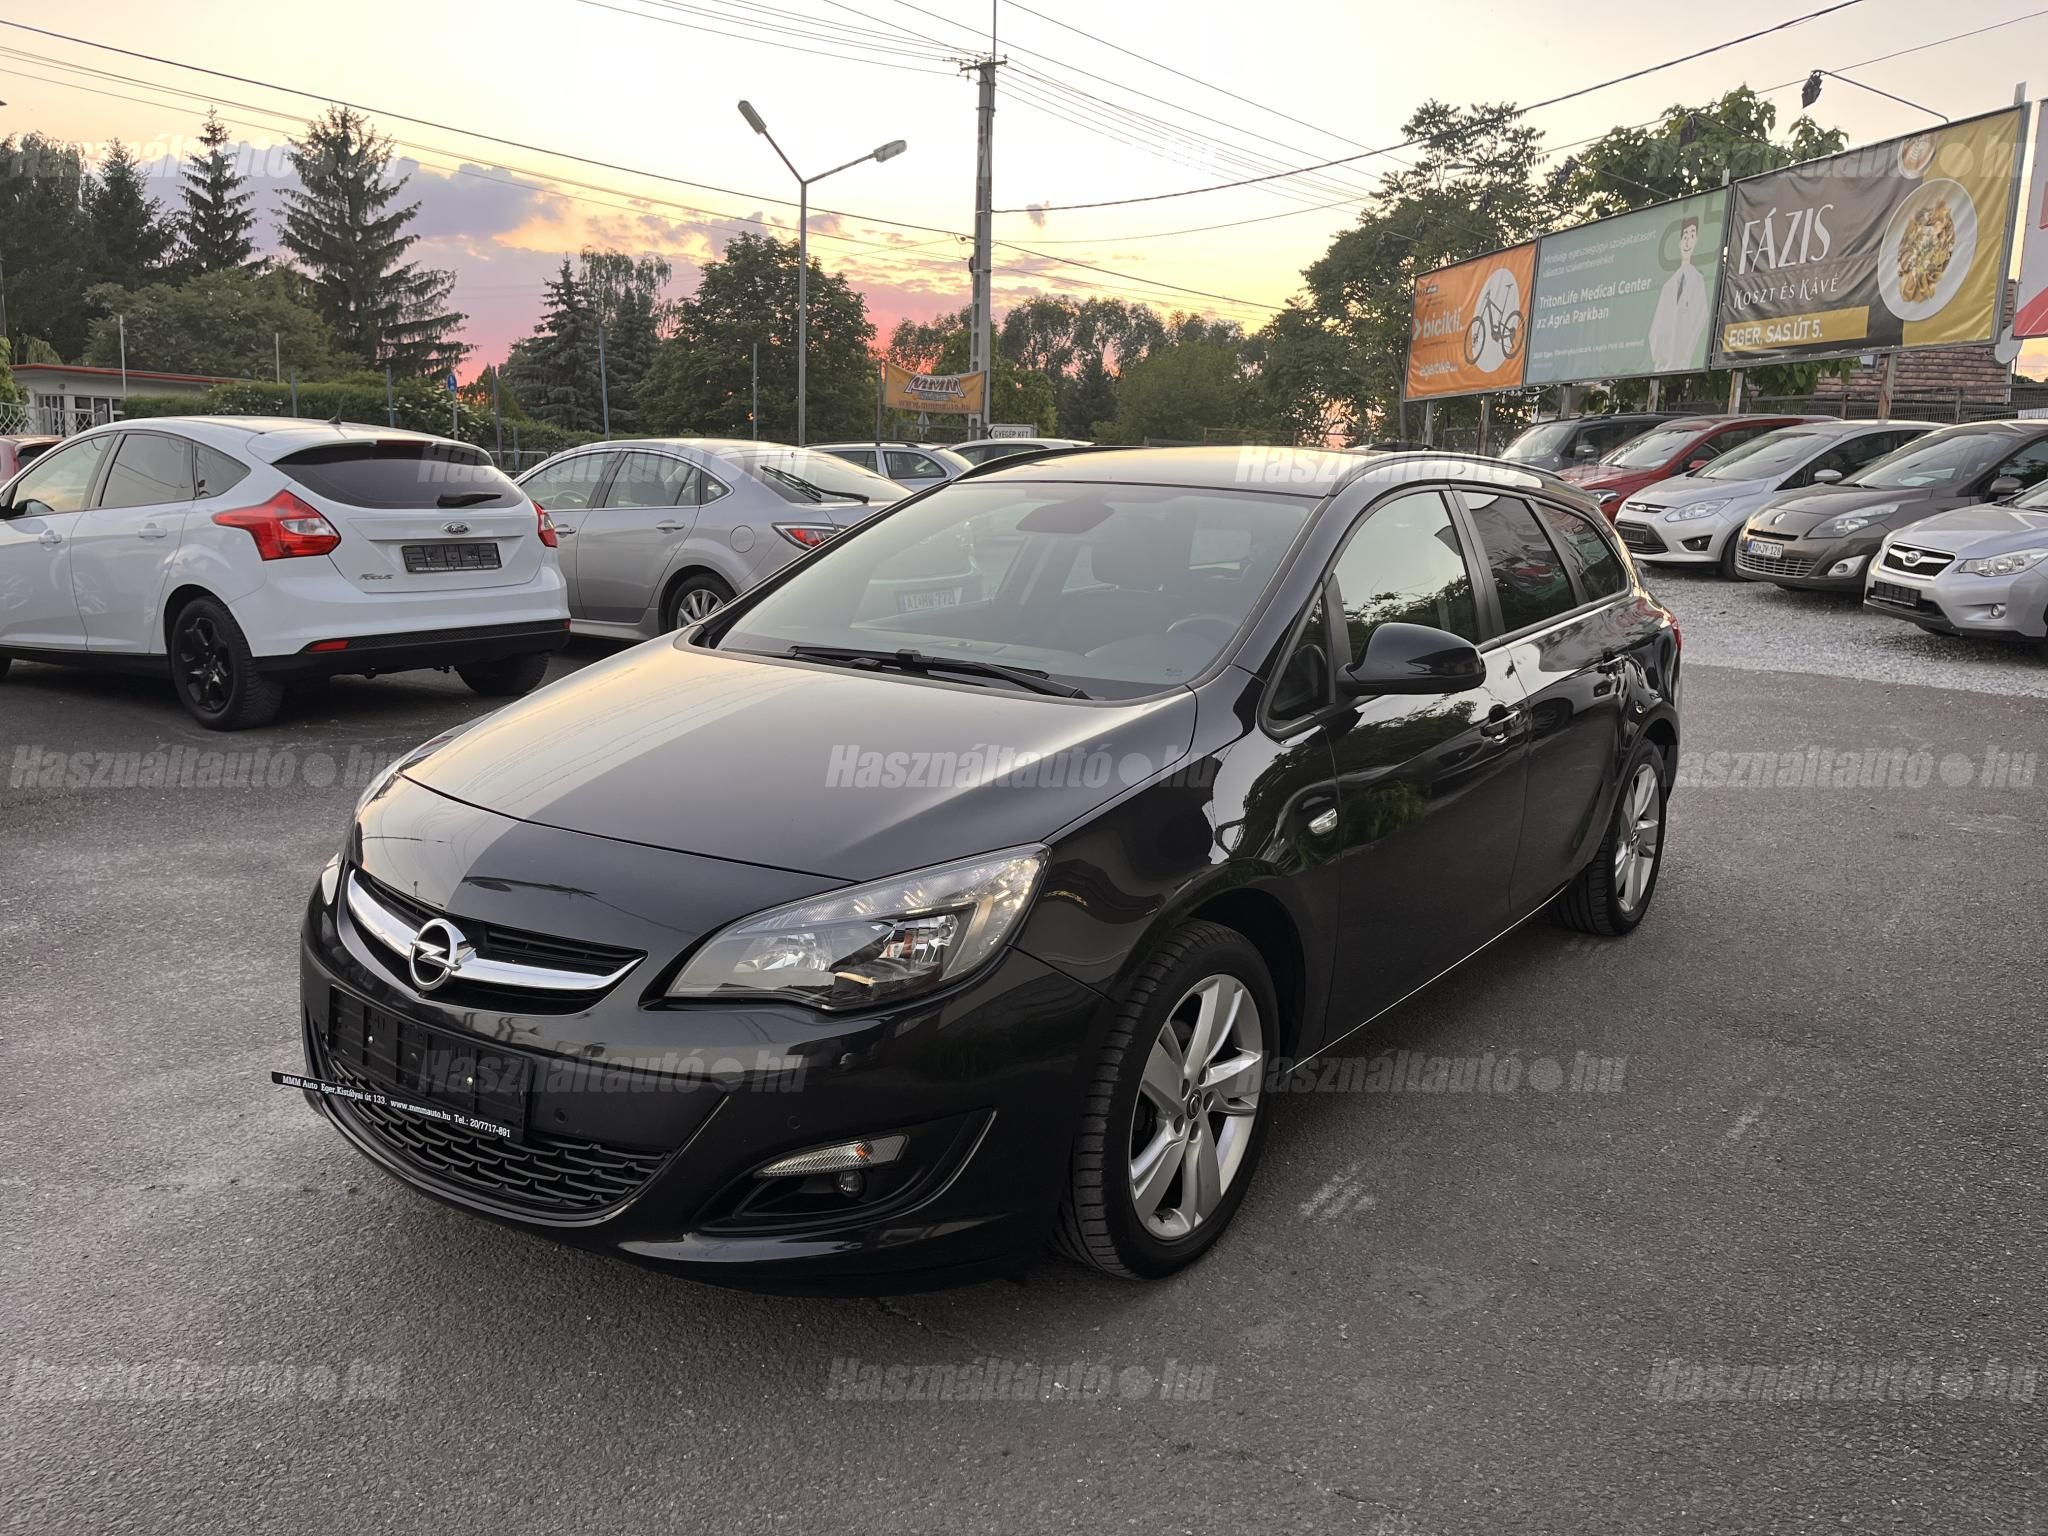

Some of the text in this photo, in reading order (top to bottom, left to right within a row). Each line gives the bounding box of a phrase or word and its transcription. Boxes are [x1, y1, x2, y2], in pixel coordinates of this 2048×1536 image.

[1738, 204, 1834, 275] FÁZIS
[1539, 278, 1652, 309] TritonLife Medical Center
[1734, 273, 1840, 310] KOSZT ÉS KÁVÉ
[1536, 307, 1609, 329] az Agria Parkban
[1766, 324, 1791, 342] SAS
[1794, 318, 1811, 339] ÚT
[1812, 319, 1823, 338] 5.
[282, 1075, 301, 1087] MMM
[302, 1078, 318, 1090] Auto
[373, 1094, 388, 1105] 133.
[390, 1099, 451, 1121] www.mmmauto.hu
[453, 1114, 469, 1126] Tel.:
[470, 1118, 512, 1138] 20/7717-891
